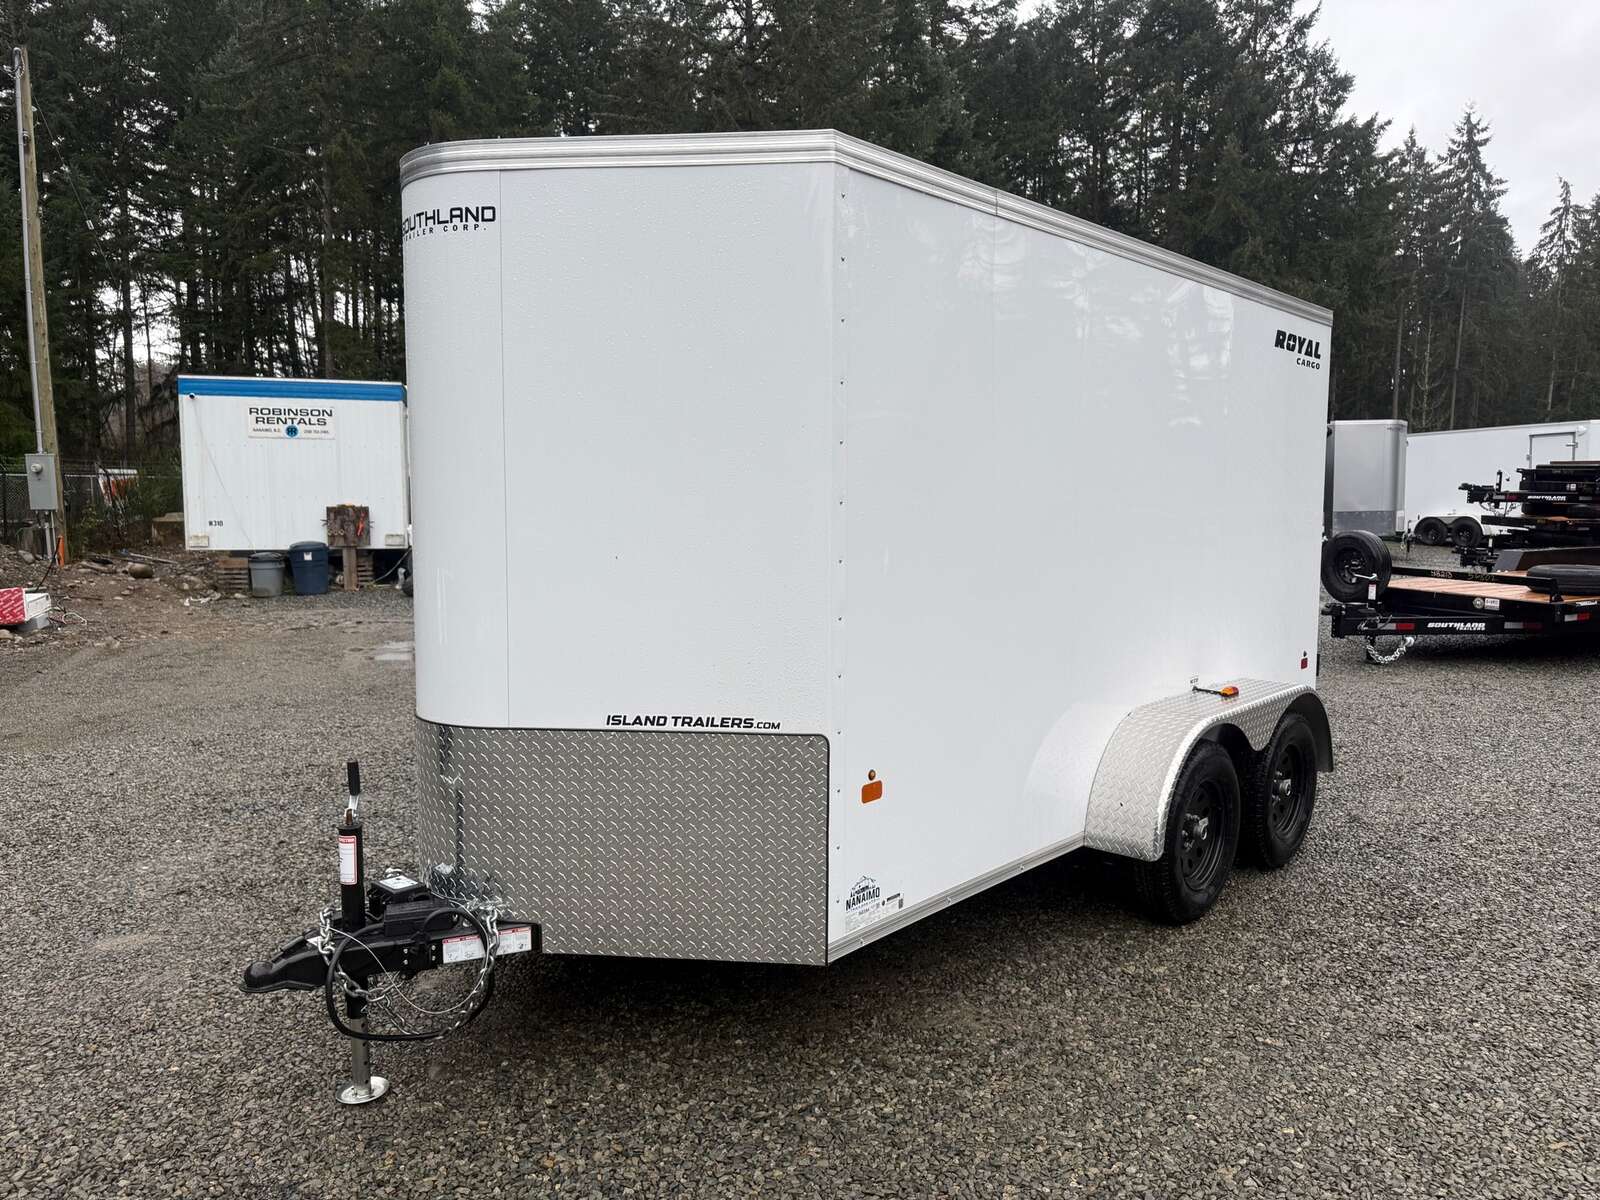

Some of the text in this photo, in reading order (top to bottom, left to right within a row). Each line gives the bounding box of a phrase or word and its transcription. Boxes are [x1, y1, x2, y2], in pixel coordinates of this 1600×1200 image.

[443, 223, 487, 232] CORP.
[1274, 329, 1321, 360] ROYAL
[1296, 357, 1321, 370] CARGO
[249, 407, 333, 417] ROBINSON
[255, 416, 327, 426] RENTALS
[606, 714, 781, 730] ISLAND TRAILERS.COM
[845, 887, 880, 911] NANAIMO
